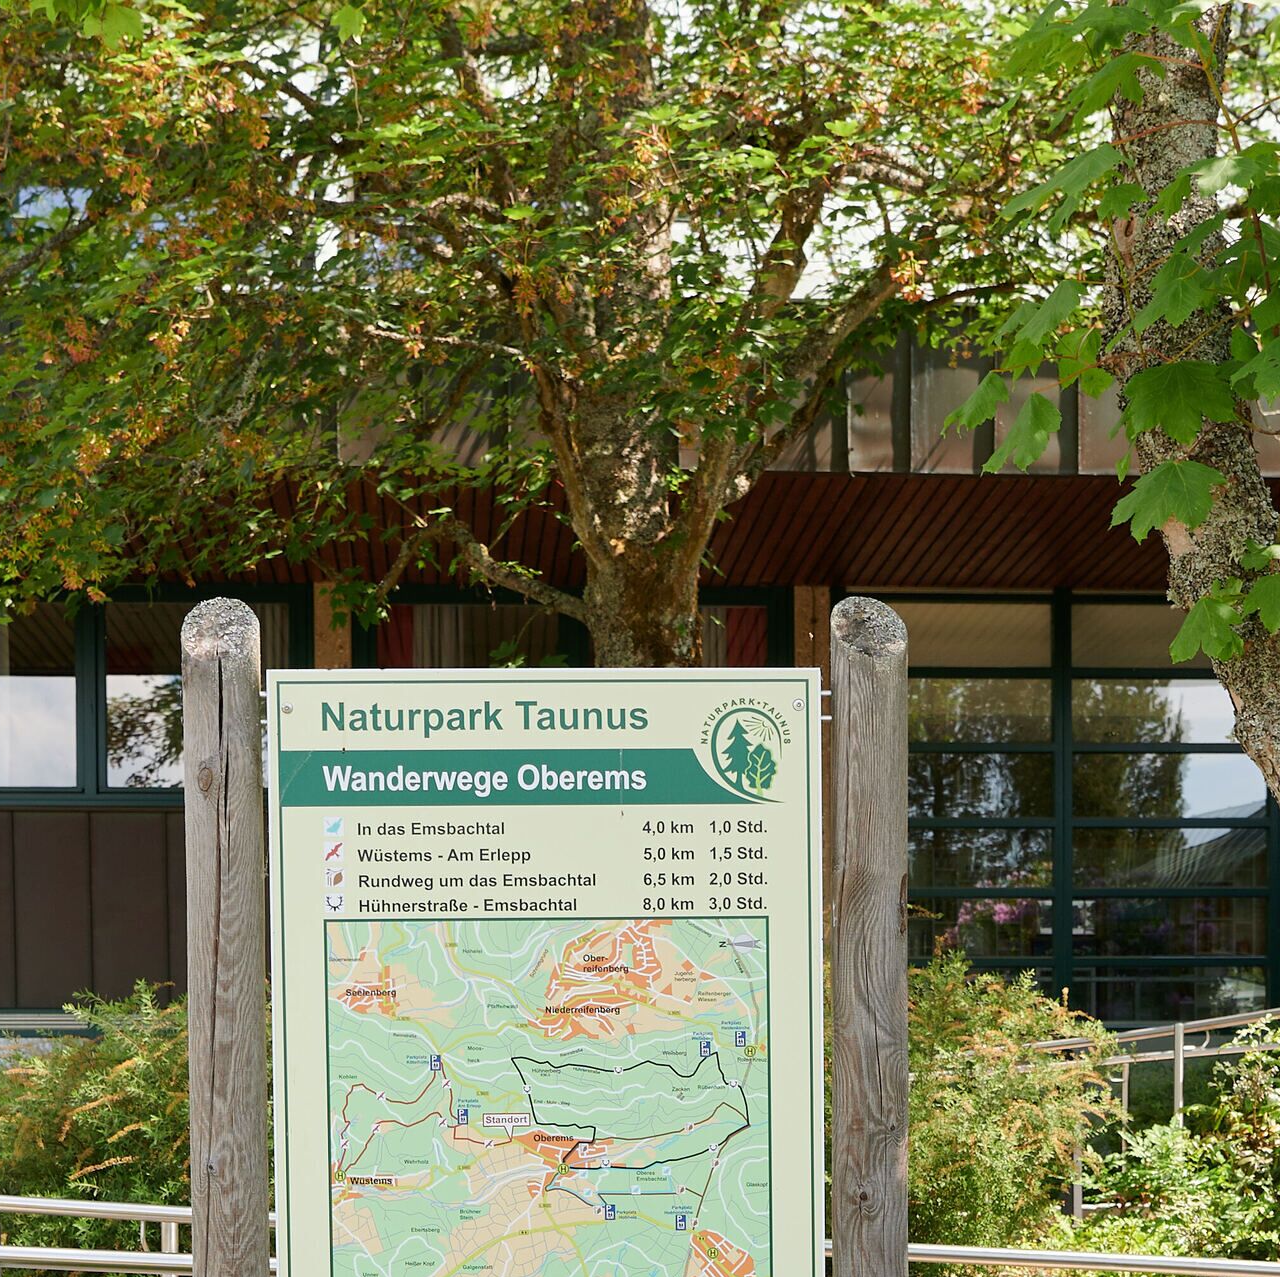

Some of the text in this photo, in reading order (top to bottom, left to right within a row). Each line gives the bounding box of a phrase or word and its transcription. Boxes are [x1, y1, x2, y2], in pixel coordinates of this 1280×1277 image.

[322, 701, 648, 738] Naturpark Taunus
[700, 698, 791, 744] NATURPARK TAUNUS
[323, 764, 646, 797] Wanderwege Oberems
[358, 822, 505, 835] In das Emsbachtal
[643, 821, 767, 835] 4,0 km 1,0 Std.
[358, 848, 432, 861] Wüstems
[448, 849, 473, 861] Am
[480, 849, 531, 864] Erlepp
[644, 847, 767, 862] 5,0 km 1,5 Std.
[358, 874, 596, 890] Rundweg um das Emsbachtal
[644, 872, 767, 887] 6,5 km 2,0 Std.
[359, 899, 468, 912] Hühnerstraße
[484, 899, 577, 912] Emsbachtal
[644, 897, 767, 911] 8,0 km 3,0 Std.
[583, 954, 609, 963] Ober-
[583, 965, 629, 974] reifenberg
[345, 989, 397, 998] Seelenberg
[545, 1005, 621, 1016] Niederreifenberg
[485, 1116, 528, 1124] Standort
[533, 1134, 575, 1143] Oberems
[350, 1177, 393, 1185] Wüstems
